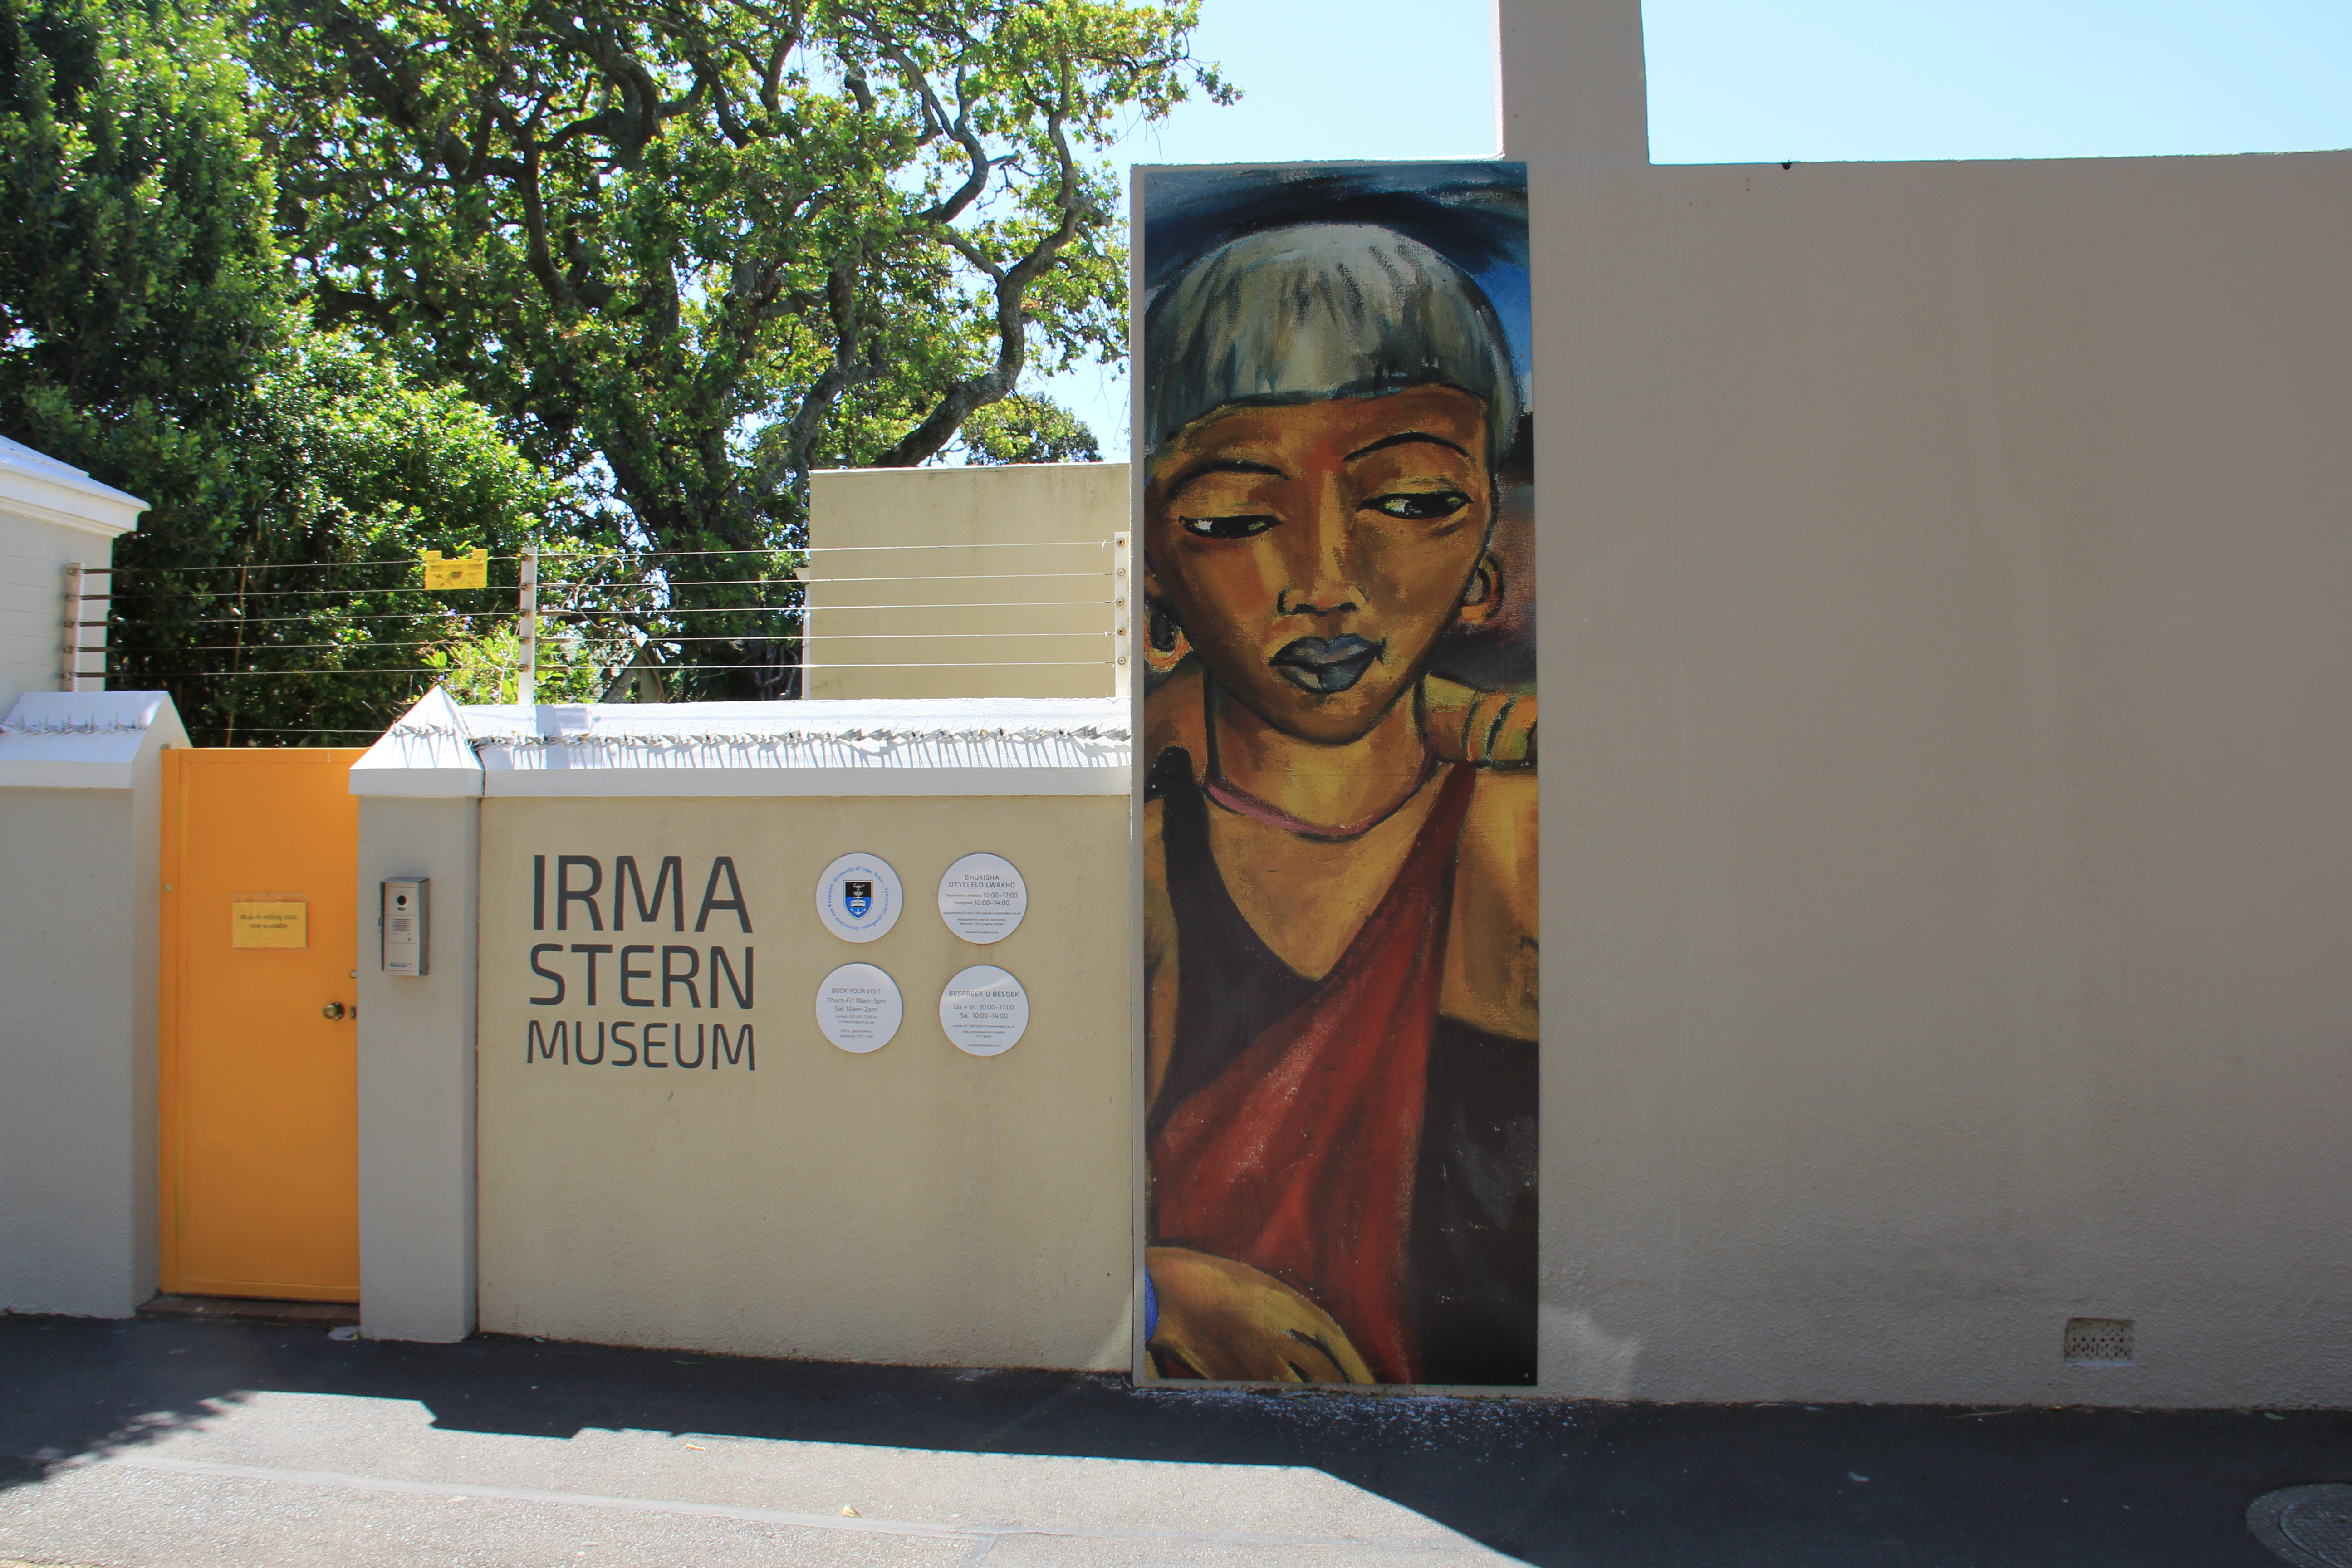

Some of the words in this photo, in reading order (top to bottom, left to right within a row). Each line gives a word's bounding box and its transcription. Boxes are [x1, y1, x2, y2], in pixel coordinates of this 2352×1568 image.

[534, 855, 754, 933] IRMA
[833, 867, 854, 882] University
[874, 872, 883, 882] Town
[530, 943, 754, 1009] STERN
[527, 1020, 755, 1071] MUSEUM
